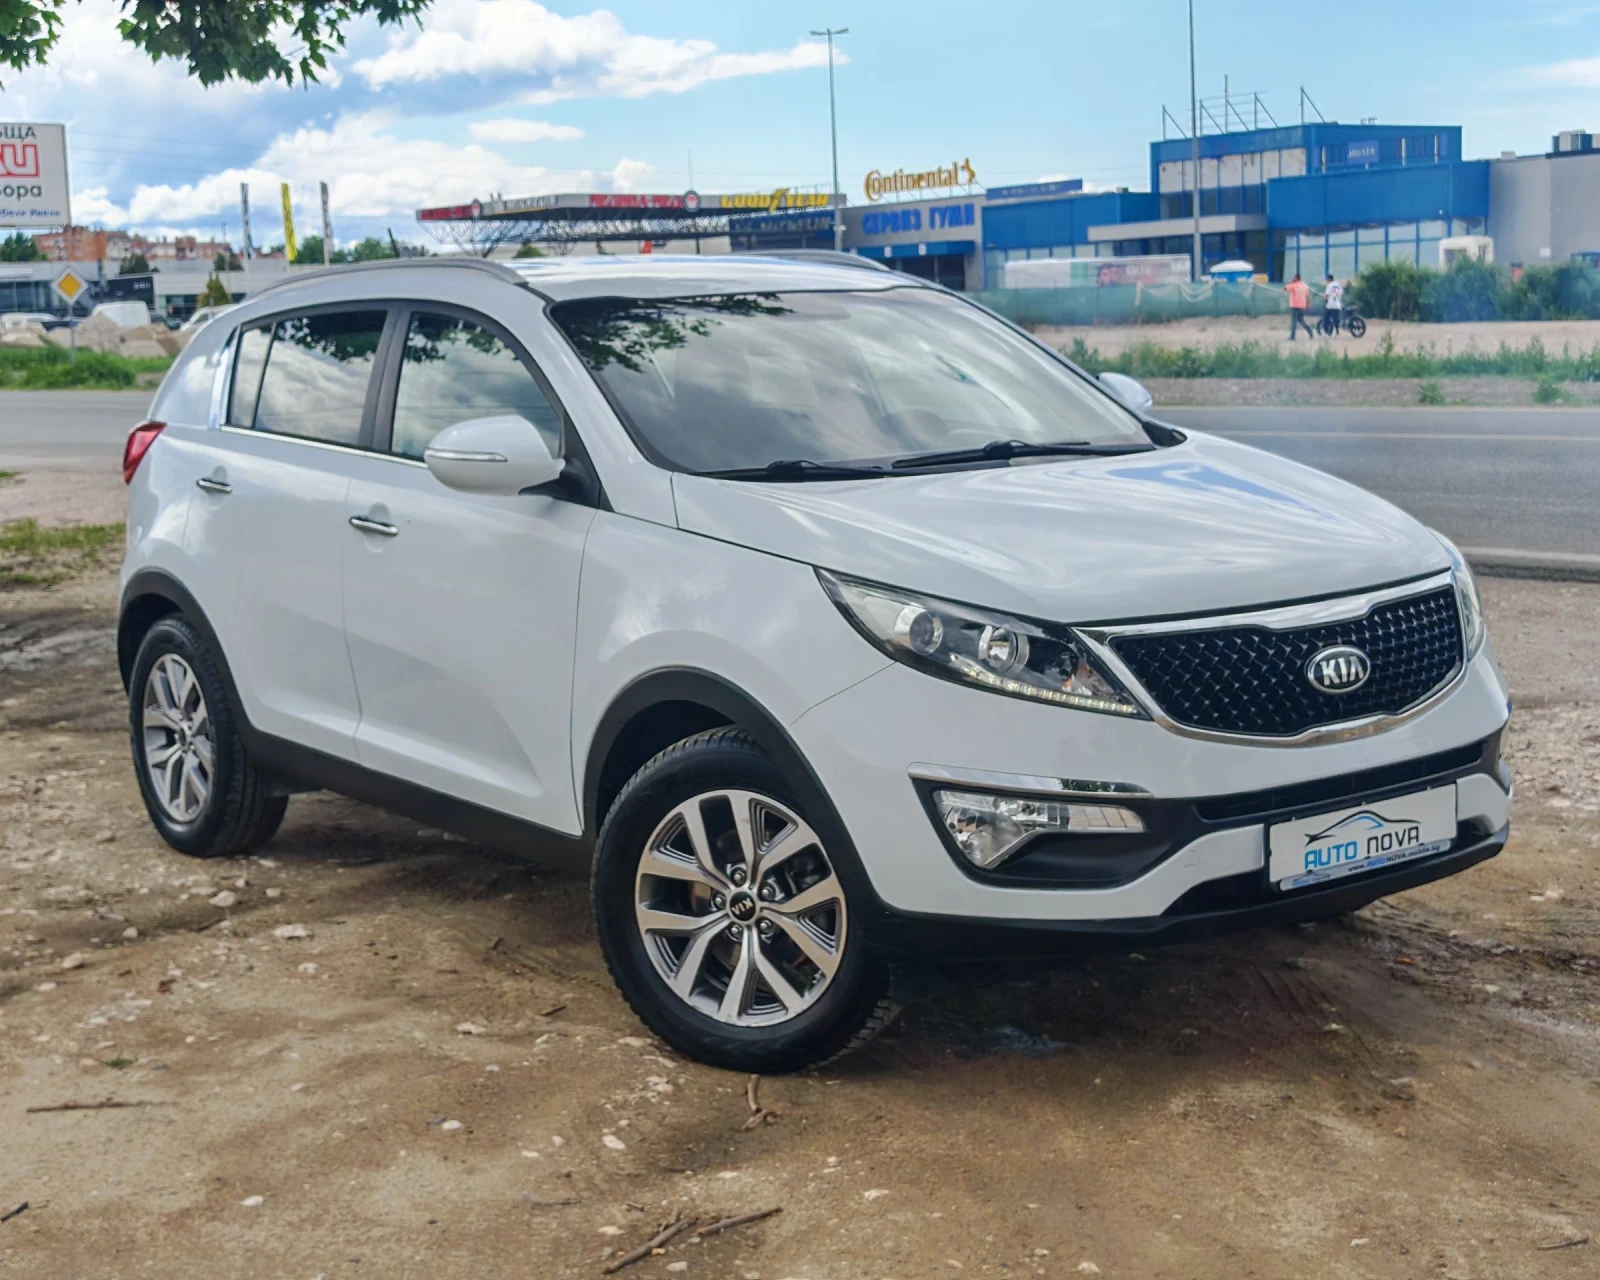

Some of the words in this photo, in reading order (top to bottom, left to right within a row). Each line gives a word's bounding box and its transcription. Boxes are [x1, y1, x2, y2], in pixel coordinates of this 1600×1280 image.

[0, 185, 42, 201] ора
[864, 161, 960, 203] Continental
[929, 203, 975, 230] ГУМИ
[1319, 655, 1364, 686] KIA
[1304, 840, 1358, 870] AUTO
[1366, 825, 1420, 855] NOVA
[731, 898, 754, 915] KIA
